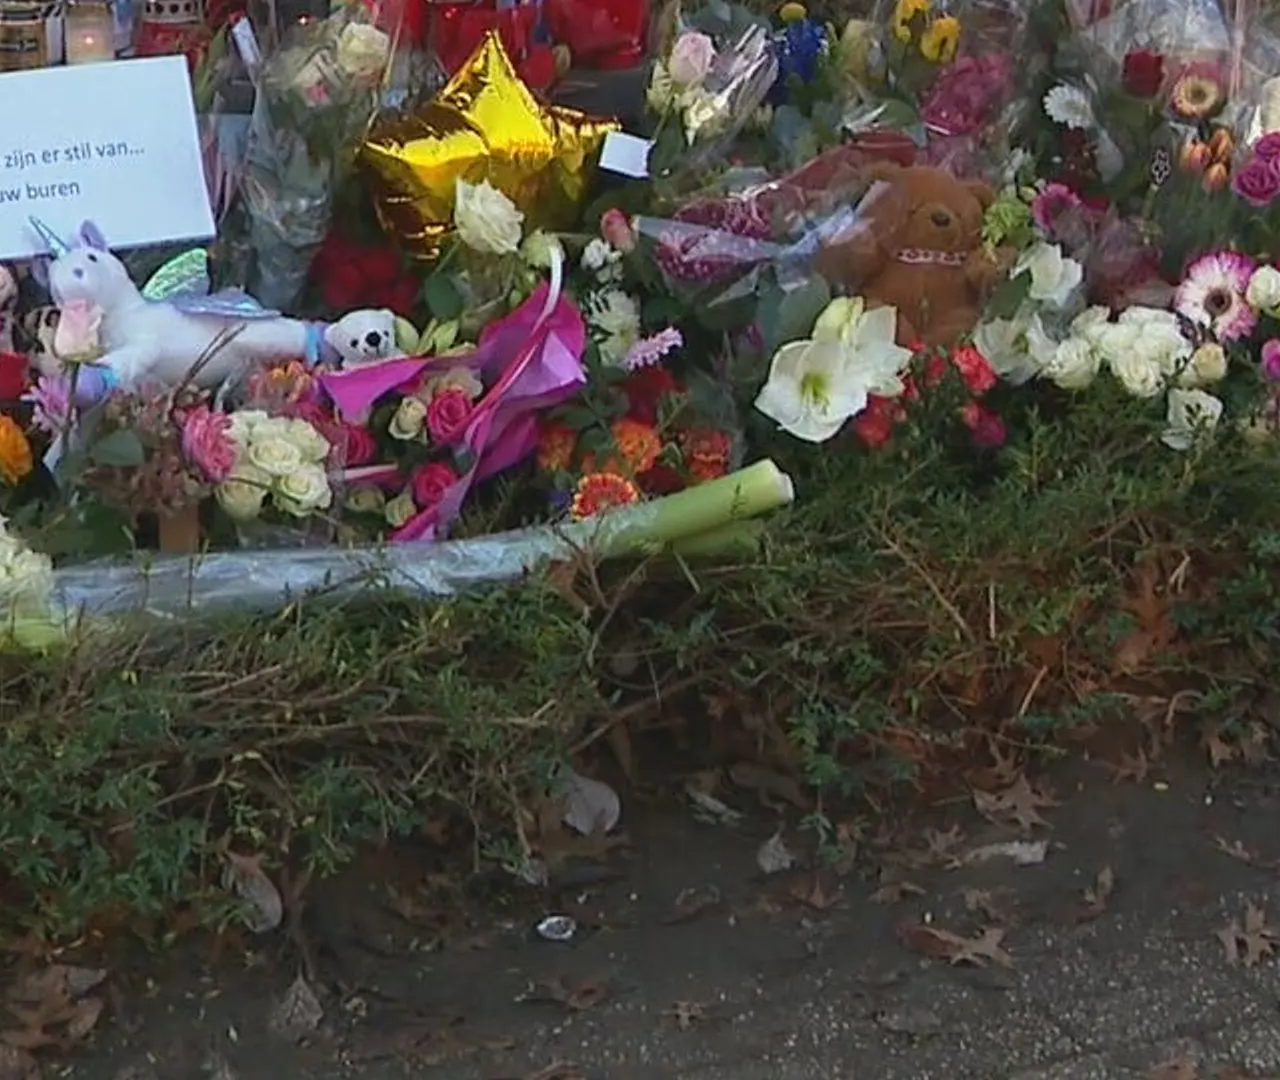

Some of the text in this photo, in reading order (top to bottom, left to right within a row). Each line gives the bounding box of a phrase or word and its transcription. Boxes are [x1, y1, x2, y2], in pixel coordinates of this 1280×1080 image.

[4, 149, 36, 169] zijn
[41, 149, 60, 163] er
[64, 142, 91, 161] stil
[95, 142, 145, 158] van...
[25, 181, 80, 199] buren
